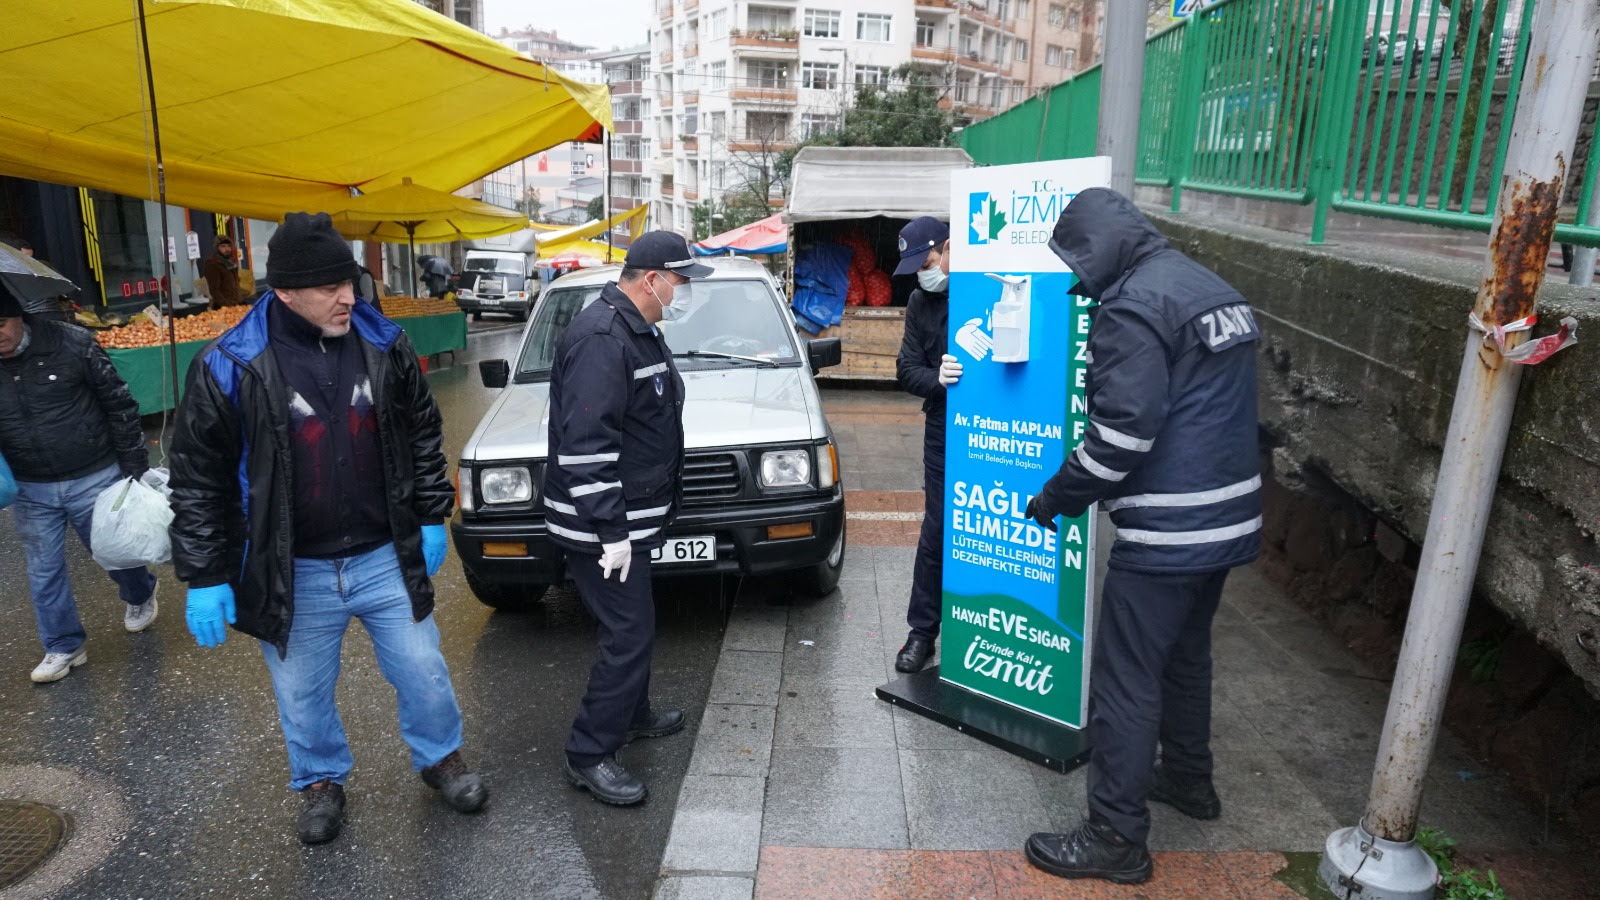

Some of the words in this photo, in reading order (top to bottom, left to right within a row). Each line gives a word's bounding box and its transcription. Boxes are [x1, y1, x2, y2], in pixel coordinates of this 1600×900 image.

[1032, 179, 1056, 193] T.C.
[954, 412, 971, 427] Av.
[973, 415, 1009, 433] Fatma
[1011, 420, 1062, 440] KAPLAN
[968, 431, 1044, 458] HÜRRİYET
[985, 453, 1014, 467] Belediye
[1015, 459, 1043, 470] Başkanı
[953, 480, 1057, 524] SAĞL
[674, 540, 708, 560] 612
[952, 534, 993, 554] LÜTFEN
[995, 544, 1056, 570] ELLERİNİZİ
[952, 548, 1022, 576] DEZENFEKTE
[1023, 566, 1055, 584] EDİN!
[951, 605, 989, 629] HAYAT
[988, 607, 1028, 640] EVE
[1028, 627, 1071, 653] SIĞAR
[979, 639, 1014, 658] Evinde
[1016, 651, 1034, 665] Kal
